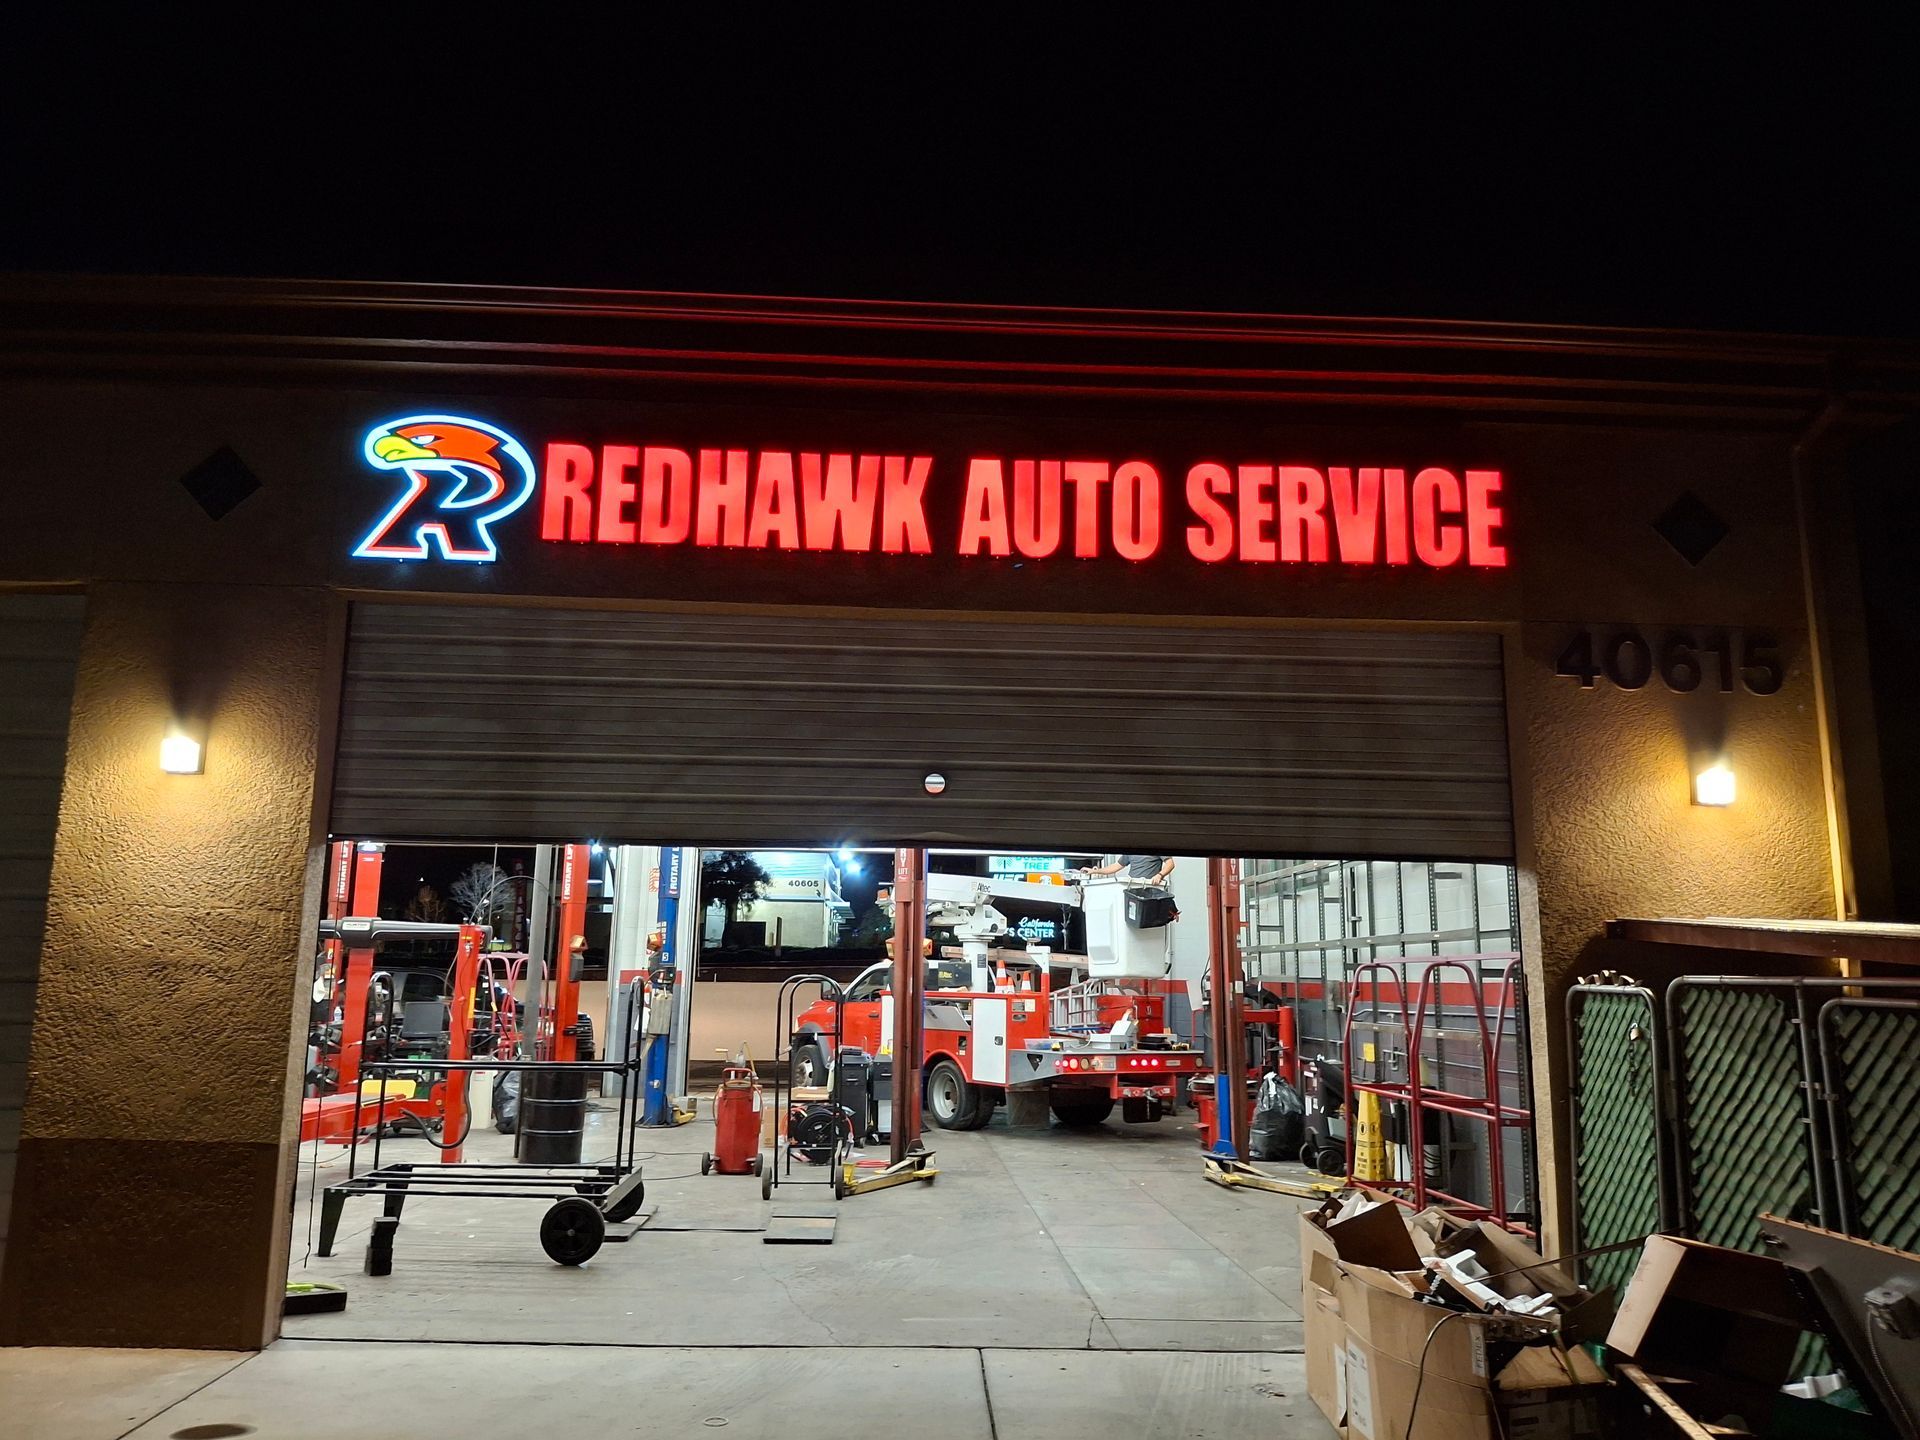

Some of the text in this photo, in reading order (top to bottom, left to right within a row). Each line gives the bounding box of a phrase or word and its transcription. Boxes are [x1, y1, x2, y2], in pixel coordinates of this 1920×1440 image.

[541, 442, 1506, 567] REDHAWK AUTO SERVICE
[1556, 631, 1784, 696] 40615
[564, 862, 572, 895] ROTARY
[669, 853, 679, 890] ROTARY
[788, 880, 819, 888] 40605
[977, 883, 991, 893] Altec
[1017, 928, 1054, 939] CENTER
[1018, 917, 1054, 929] California
